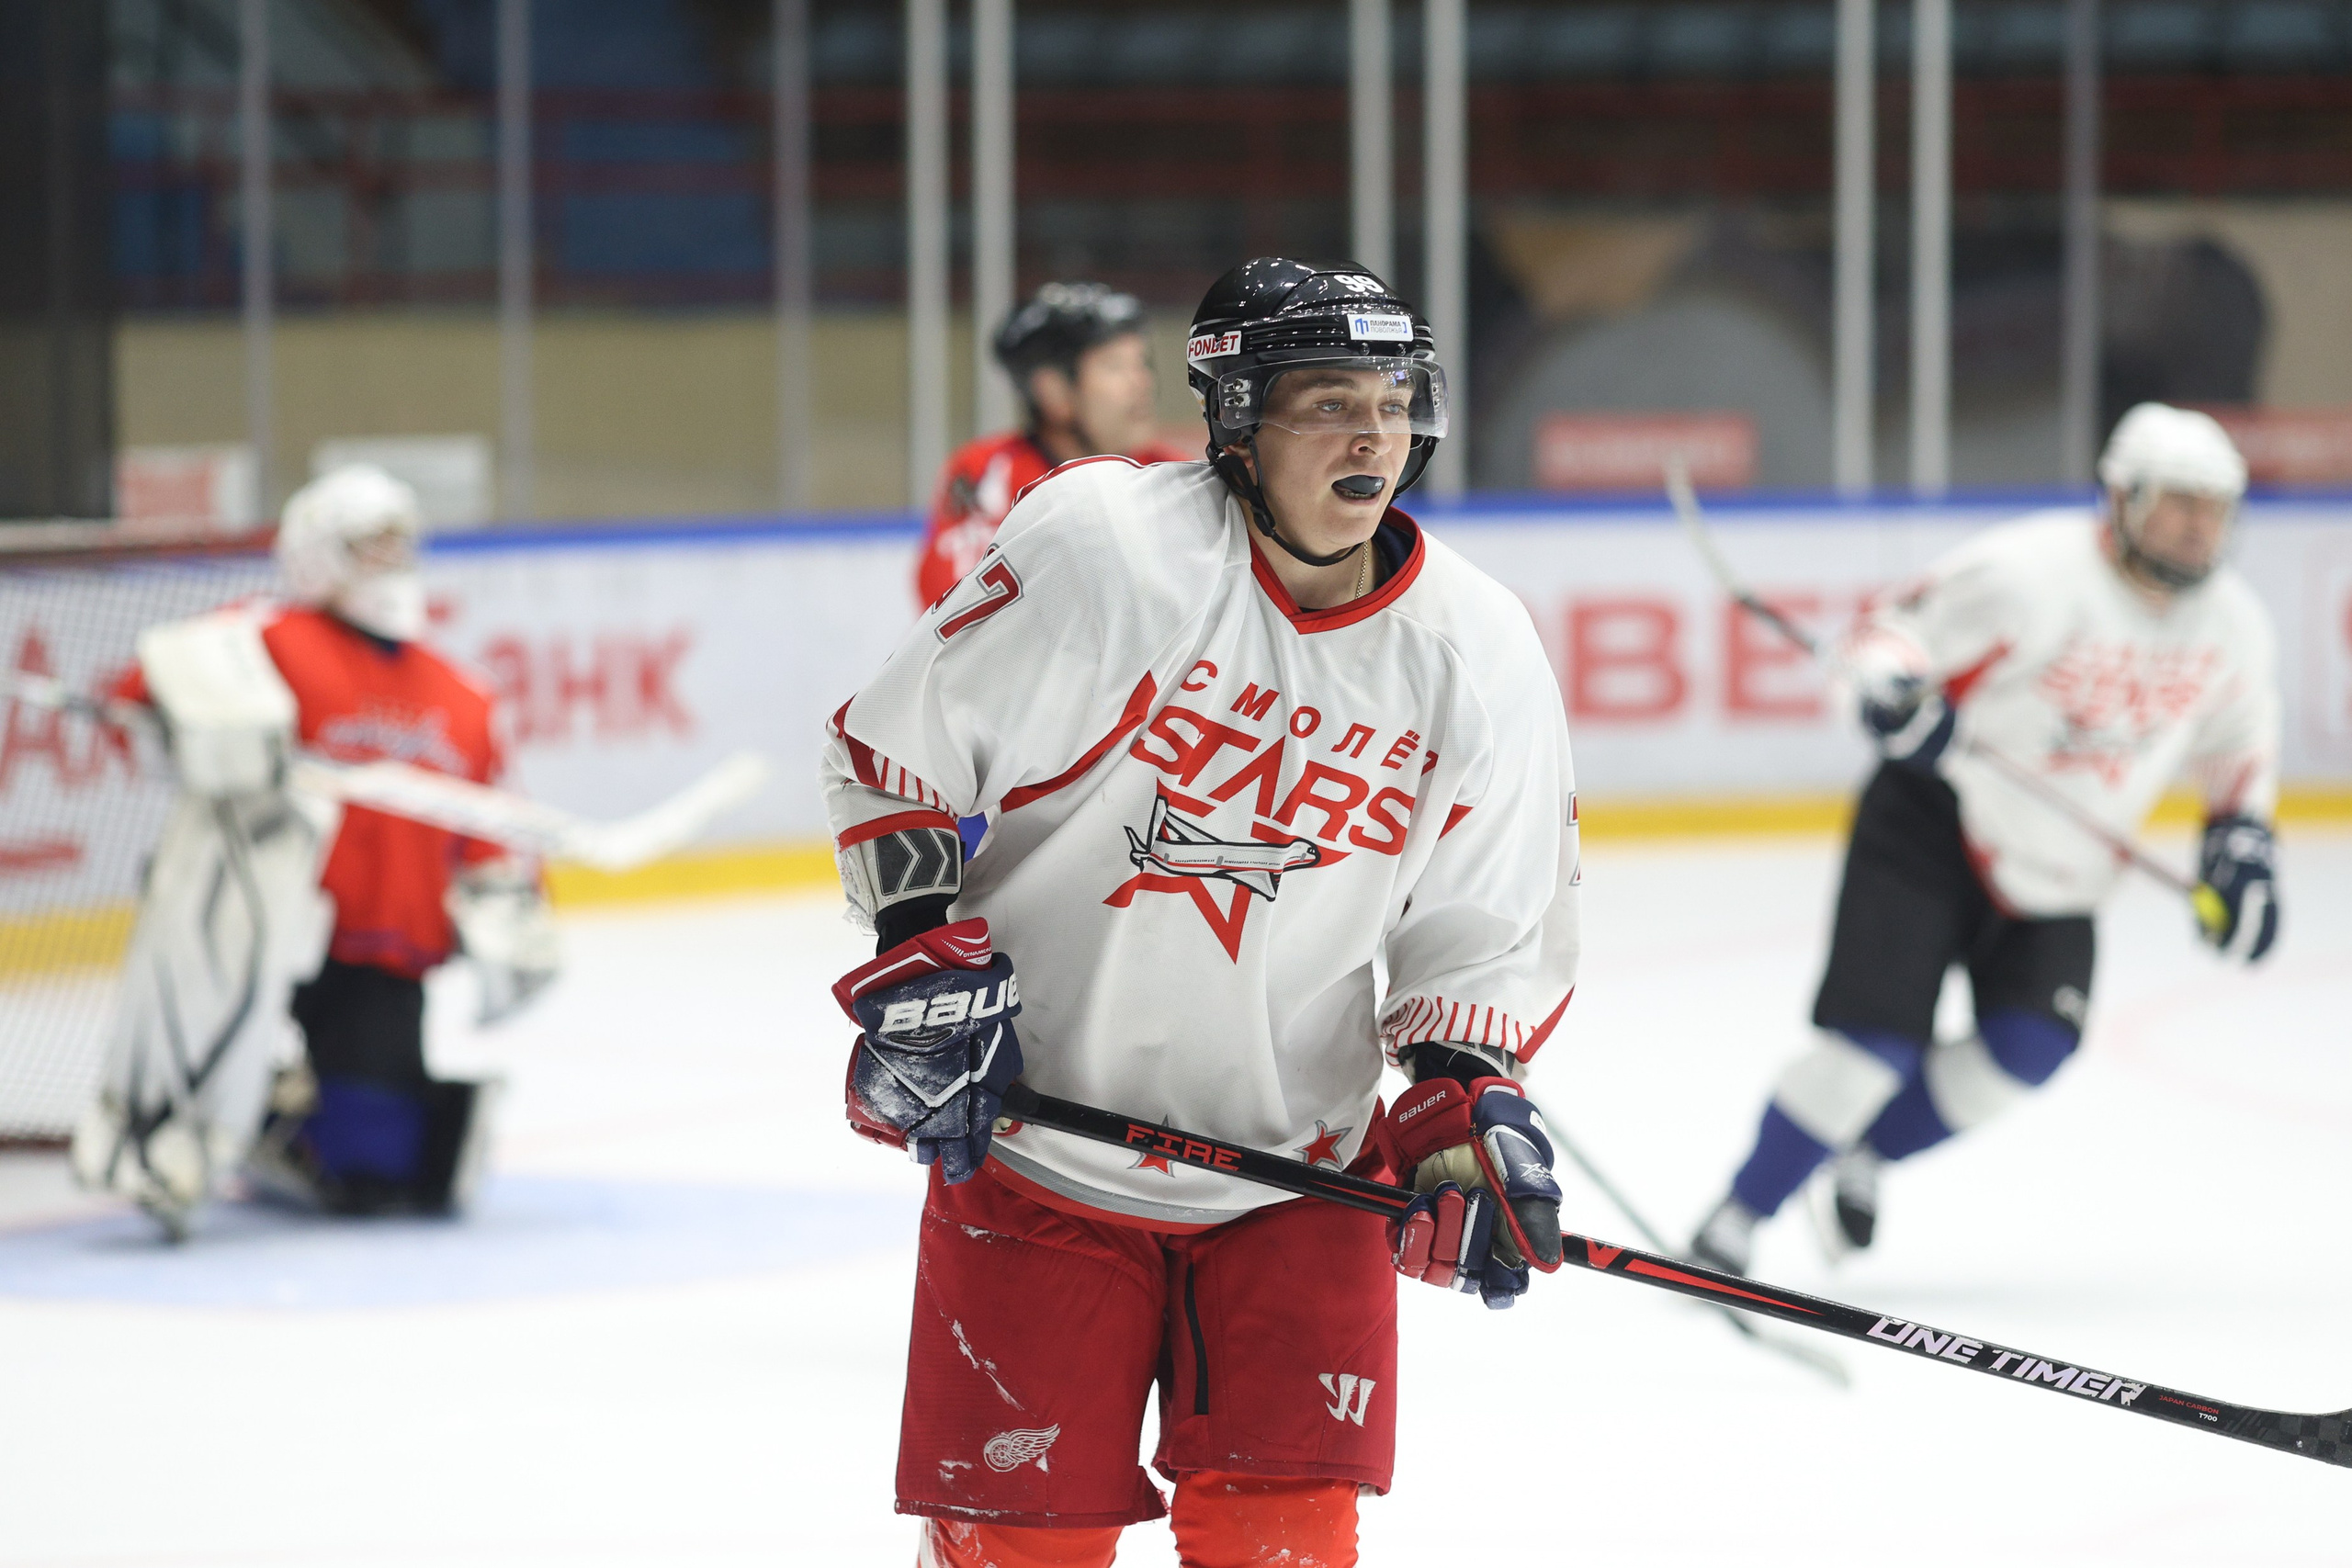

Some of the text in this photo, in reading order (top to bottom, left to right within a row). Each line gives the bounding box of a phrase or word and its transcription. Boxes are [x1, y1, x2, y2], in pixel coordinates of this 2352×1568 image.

[1333, 275, 1385, 294] 99
[1129, 705, 1416, 856] STARS
[1398, 1089, 1446, 1123] BAUER
[1125, 1122, 1242, 1172] FIRE
[1866, 1315, 2147, 1406] ONE TIMER
[2159, 1394, 2220, 1415] JAPAN CARBON
[2199, 1412, 2218, 1423] T700
